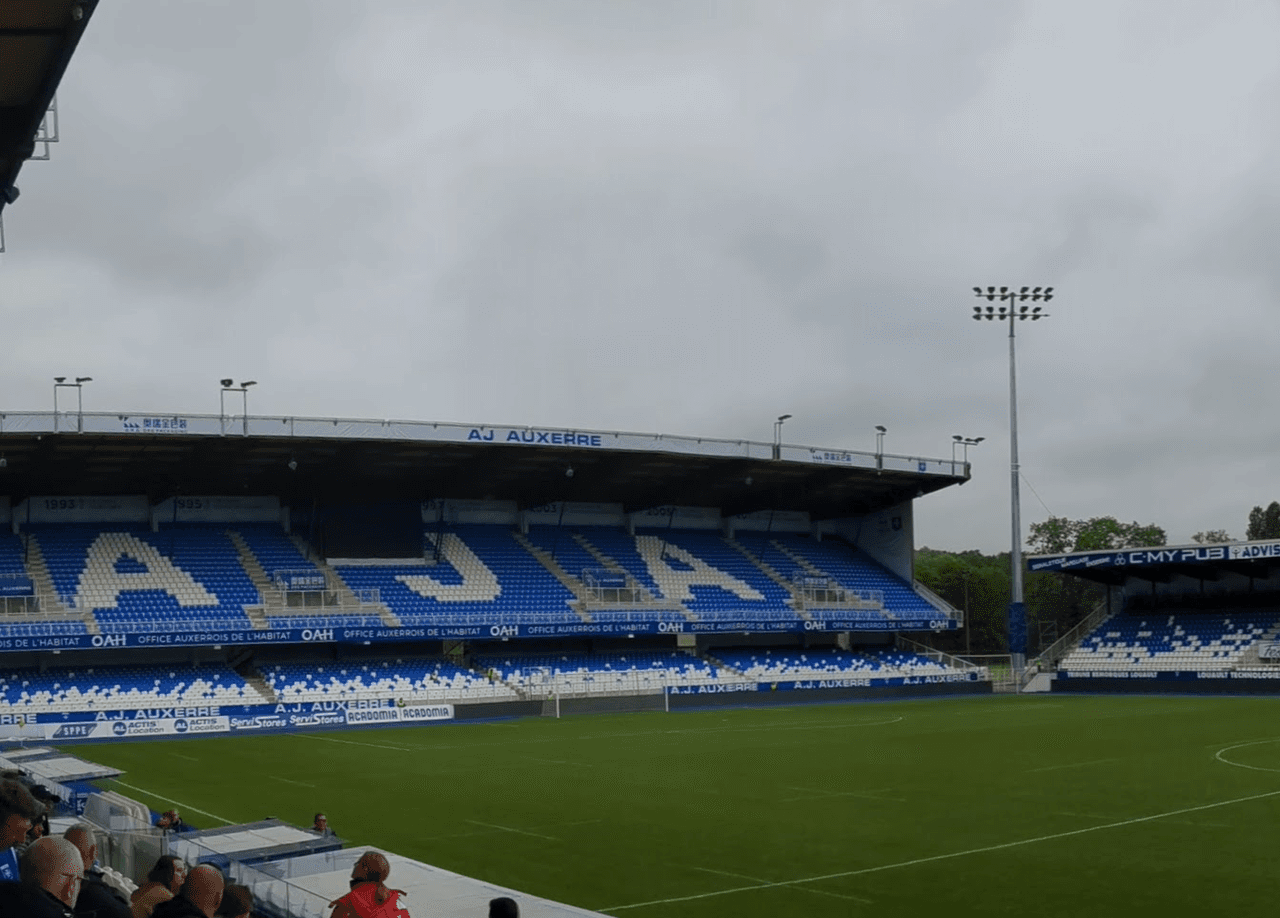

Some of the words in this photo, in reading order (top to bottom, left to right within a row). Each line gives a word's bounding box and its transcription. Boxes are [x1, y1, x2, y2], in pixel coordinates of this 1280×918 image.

[468, 429, 494, 441] AJ
[506, 430, 602, 446] AUXERRE
[1181, 548, 1225, 561] PUB
[528, 626, 555, 634] OFFICE
[557, 625, 601, 633] AUXERROIS
[603, 624, 614, 632] DE
[615, 623, 650, 632] L'HABITAT
[658, 622, 684, 632] OAH
[804, 621, 827, 630] OAH
[929, 620, 949, 629] OAH
[302, 629, 334, 640] OAH
[344, 630, 375, 638] OFFICE
[376, 629, 425, 638] AUXERROIS
[427, 628, 438, 637] DE
[441, 627, 481, 636] L'HABITAT
[490, 625, 518, 636] OAH
[15, 638, 28, 648] DE
[32, 637, 80, 647] L'HABITAT
[91, 633, 127, 648] OAH
[138, 634, 172, 644] OFFICE
[175, 633, 228, 643] AUXERROIS
[231, 632, 244, 641] DE
[247, 631, 290, 641] L'HABITAT
[925, 674, 972, 683] AUXERRE
[671, 685, 693, 694] A.J.
[699, 683, 758, 693] AUXERRE
[793, 680, 816, 690] A.J.
[819, 679, 871, 688] AUXERRE
[274, 703, 307, 713] A.J.
[312, 699, 390, 711] AUXERRE
[95, 711, 129, 721] A.J.
[134, 706, 221, 719] AUXERRE
[348, 708, 398, 721] ACADOMIA
[402, 707, 449, 719] ACADOMIA
[63, 725, 87, 736] SPPE
